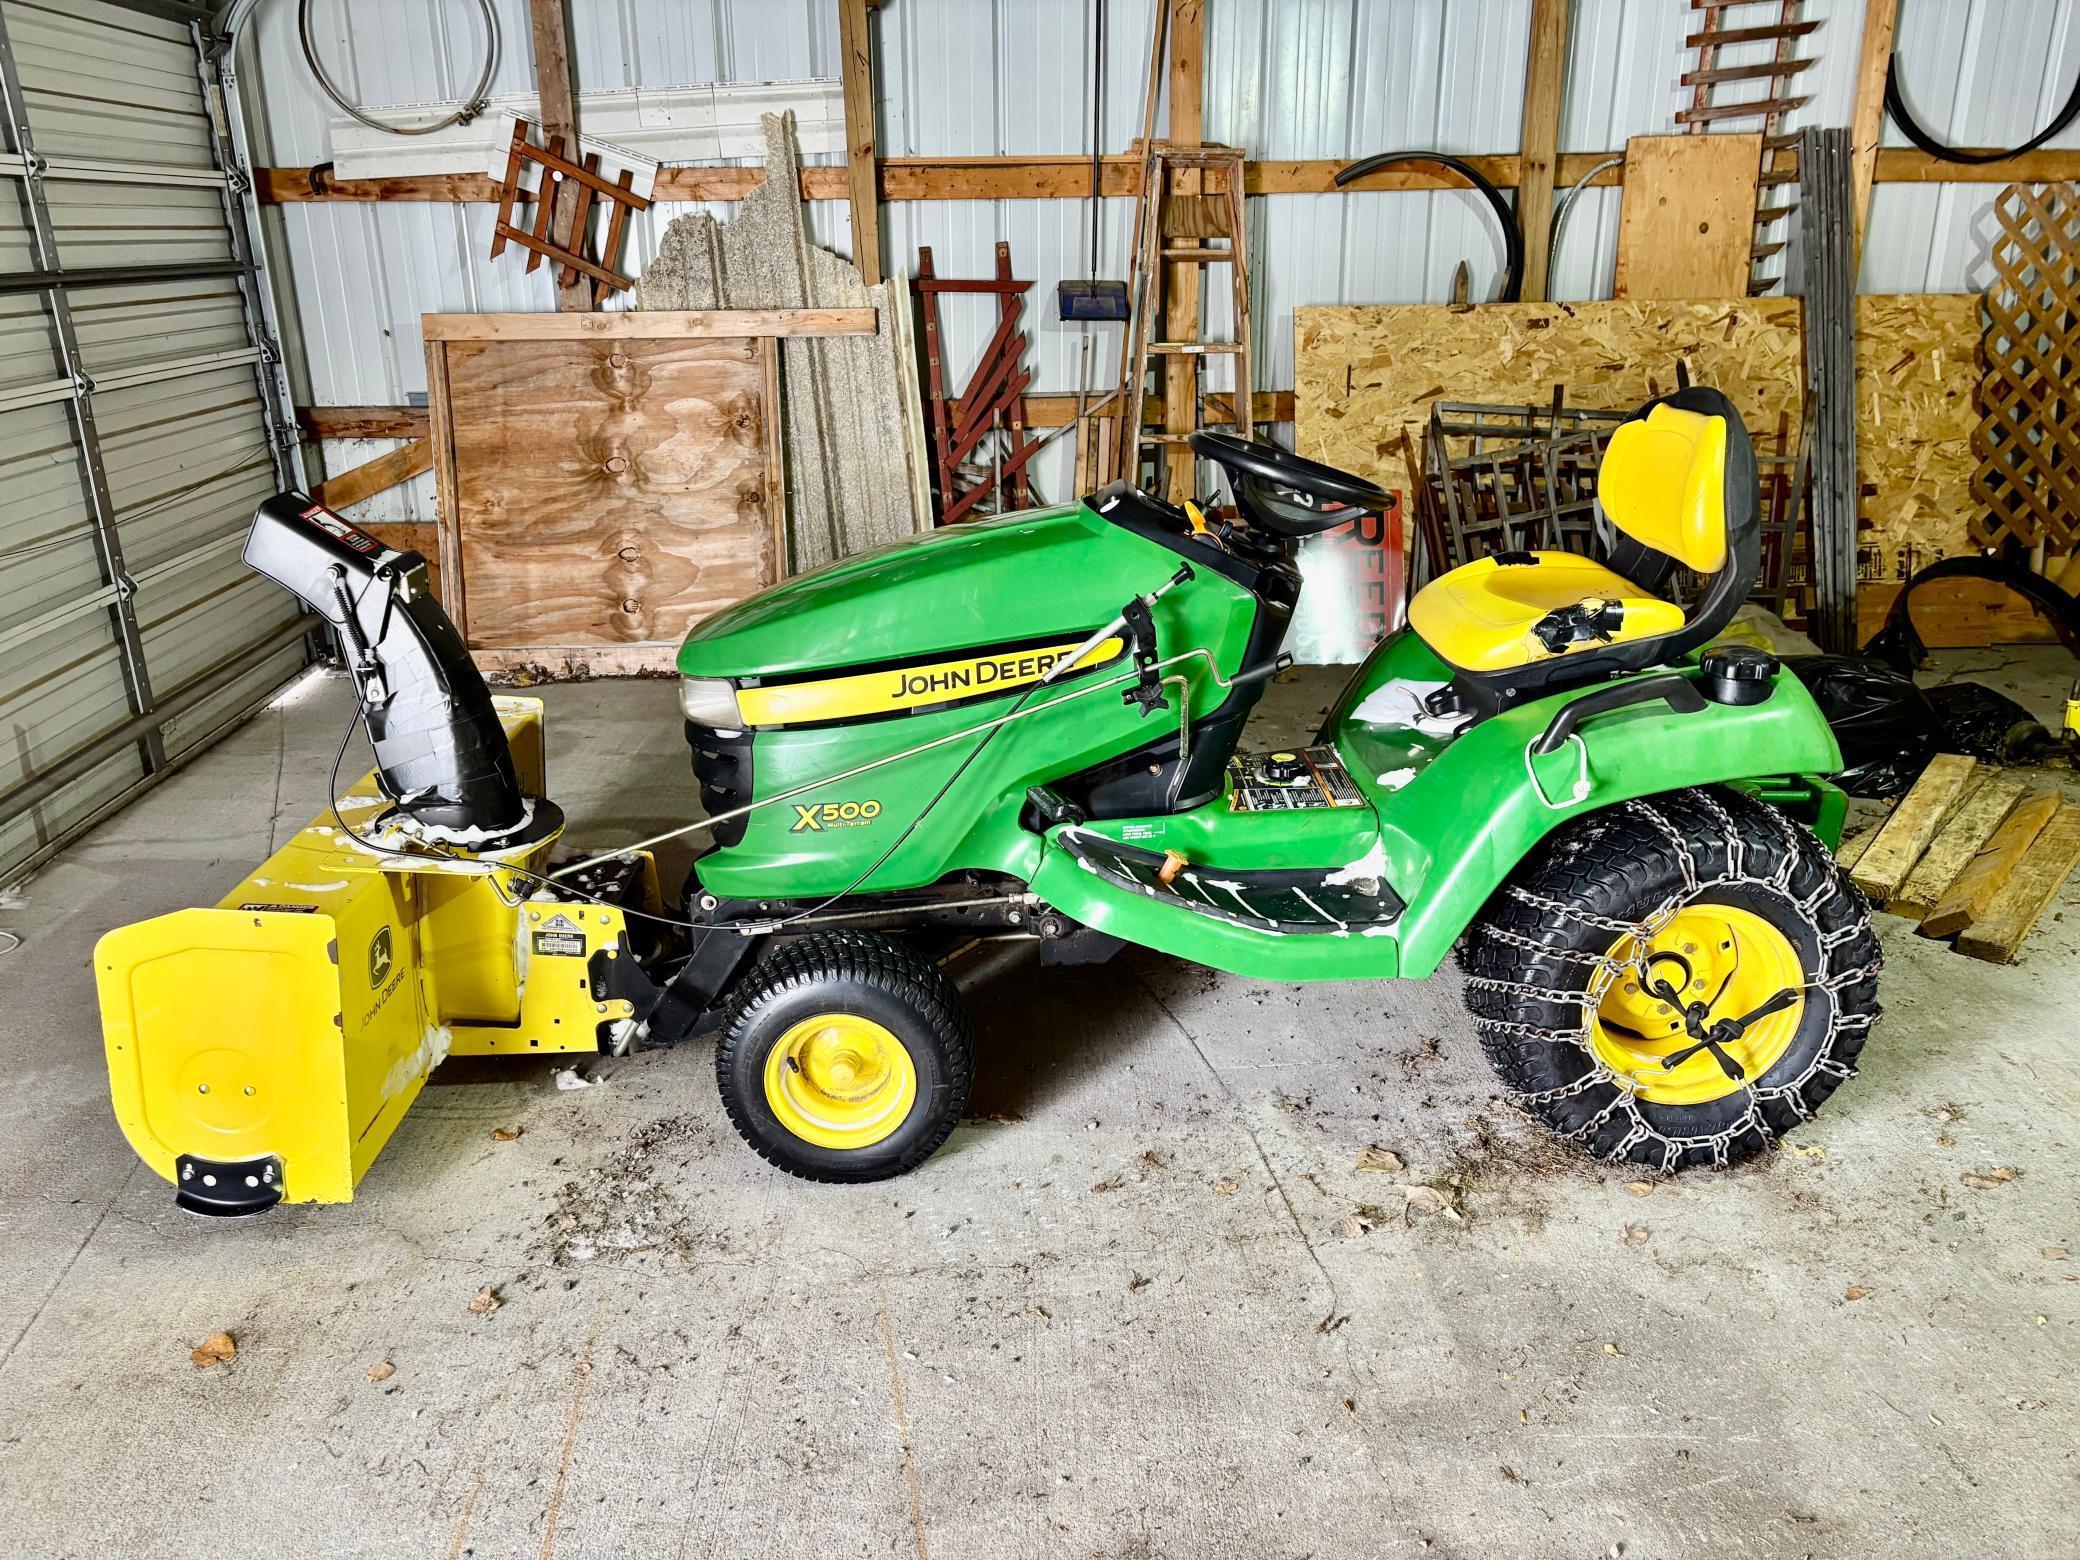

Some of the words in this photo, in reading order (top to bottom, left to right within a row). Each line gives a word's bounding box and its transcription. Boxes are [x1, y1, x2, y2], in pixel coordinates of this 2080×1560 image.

[891, 668, 970, 699] JOHN
[789, 799, 882, 833] X500
[360, 998, 381, 1034] JOHN
[381, 965, 406, 1005] DEERE
